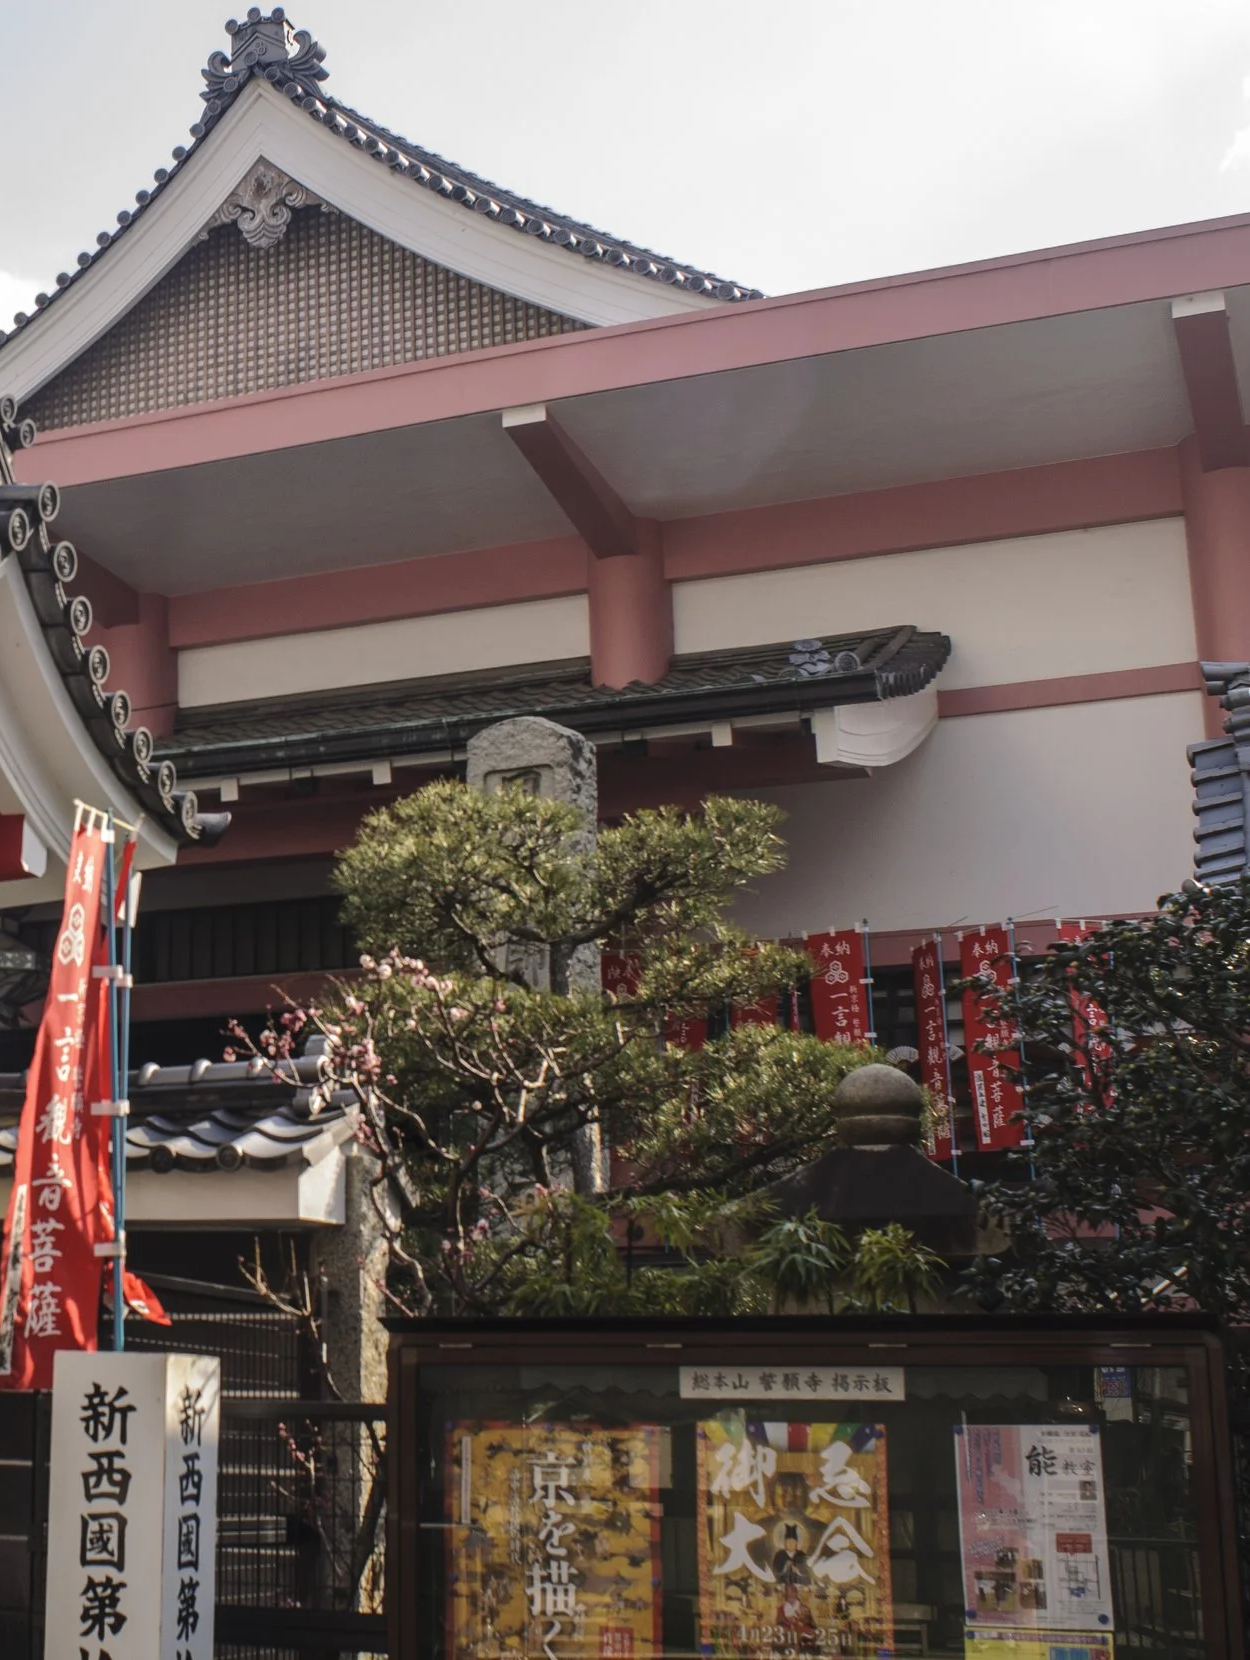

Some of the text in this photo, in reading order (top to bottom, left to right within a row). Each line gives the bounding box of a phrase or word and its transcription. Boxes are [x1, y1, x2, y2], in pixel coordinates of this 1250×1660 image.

[820, 940, 851, 957] 奉納
[973, 939, 999, 958] 奉納
[692, 1371, 893, 1394] 総本山 誓願寺 掲示板
[1025, 1445, 1058, 1476] 能
[78, 1382, 137, 1660] 新西國第
[176, 1384, 205, 1660] 新西國第
[525, 1451, 578, 1660] 京を描く
